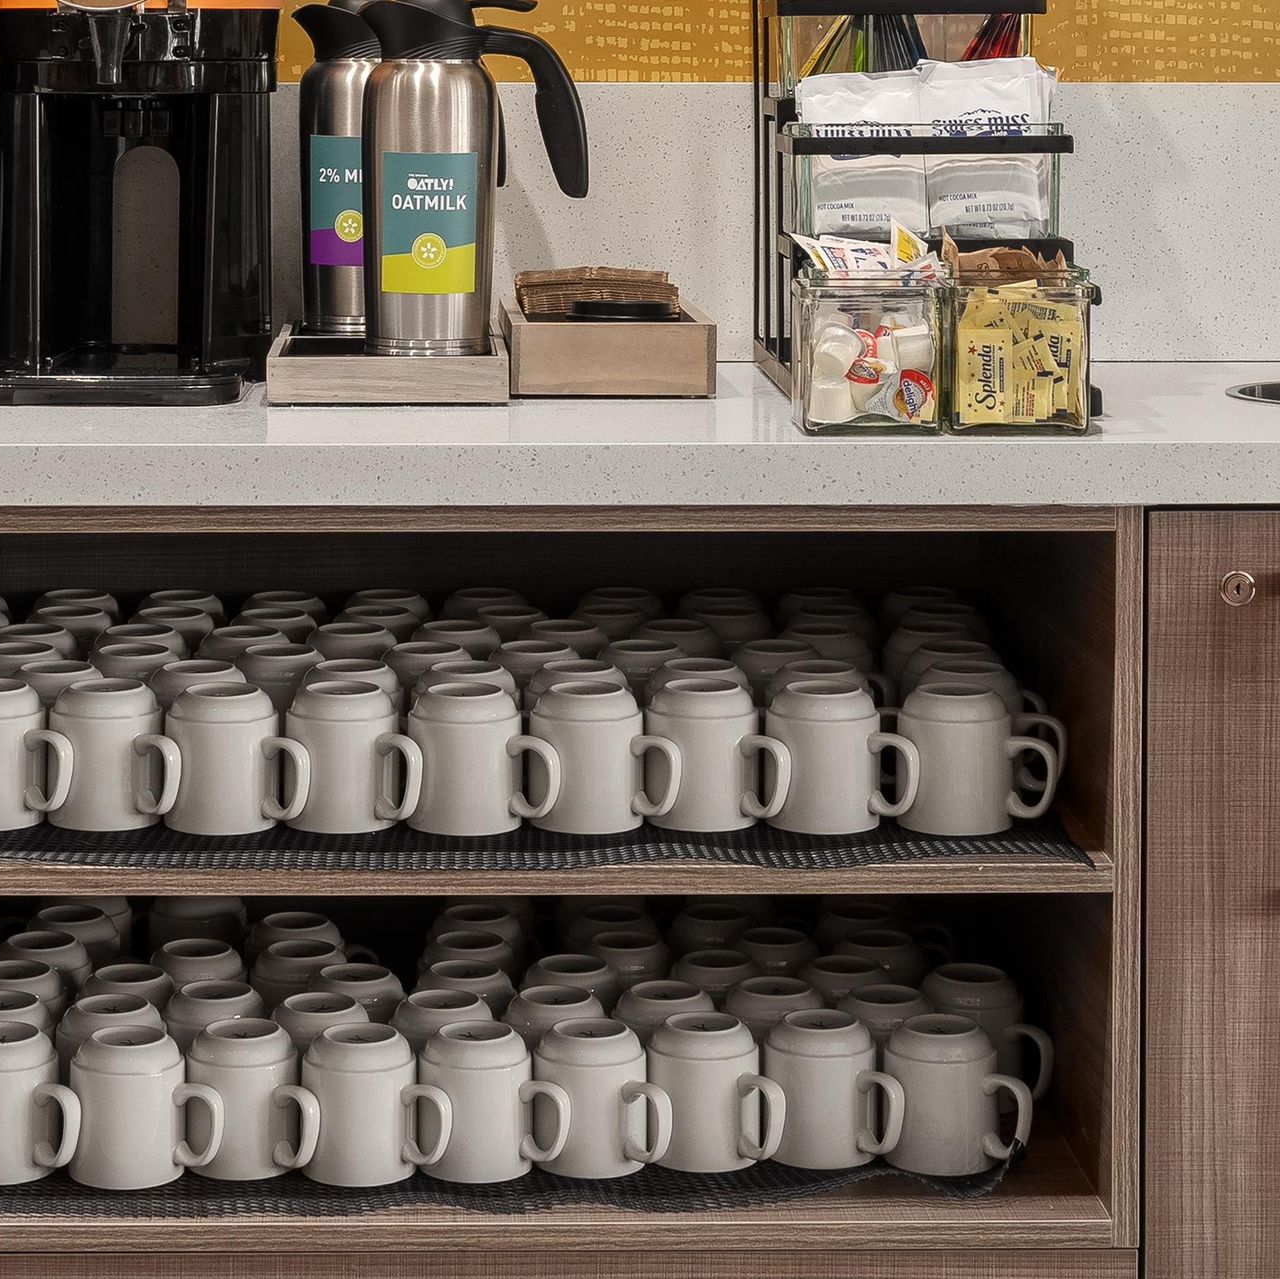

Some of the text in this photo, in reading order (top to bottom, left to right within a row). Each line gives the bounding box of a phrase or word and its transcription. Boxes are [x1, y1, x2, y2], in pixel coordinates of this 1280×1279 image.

[319, 168, 362, 183] 2% MI
[407, 178, 454, 191] OATLY!
[392, 194, 468, 210] OATMILK
[950, 193, 966, 202] COCOA
[974, 344, 997, 411] Splenda
